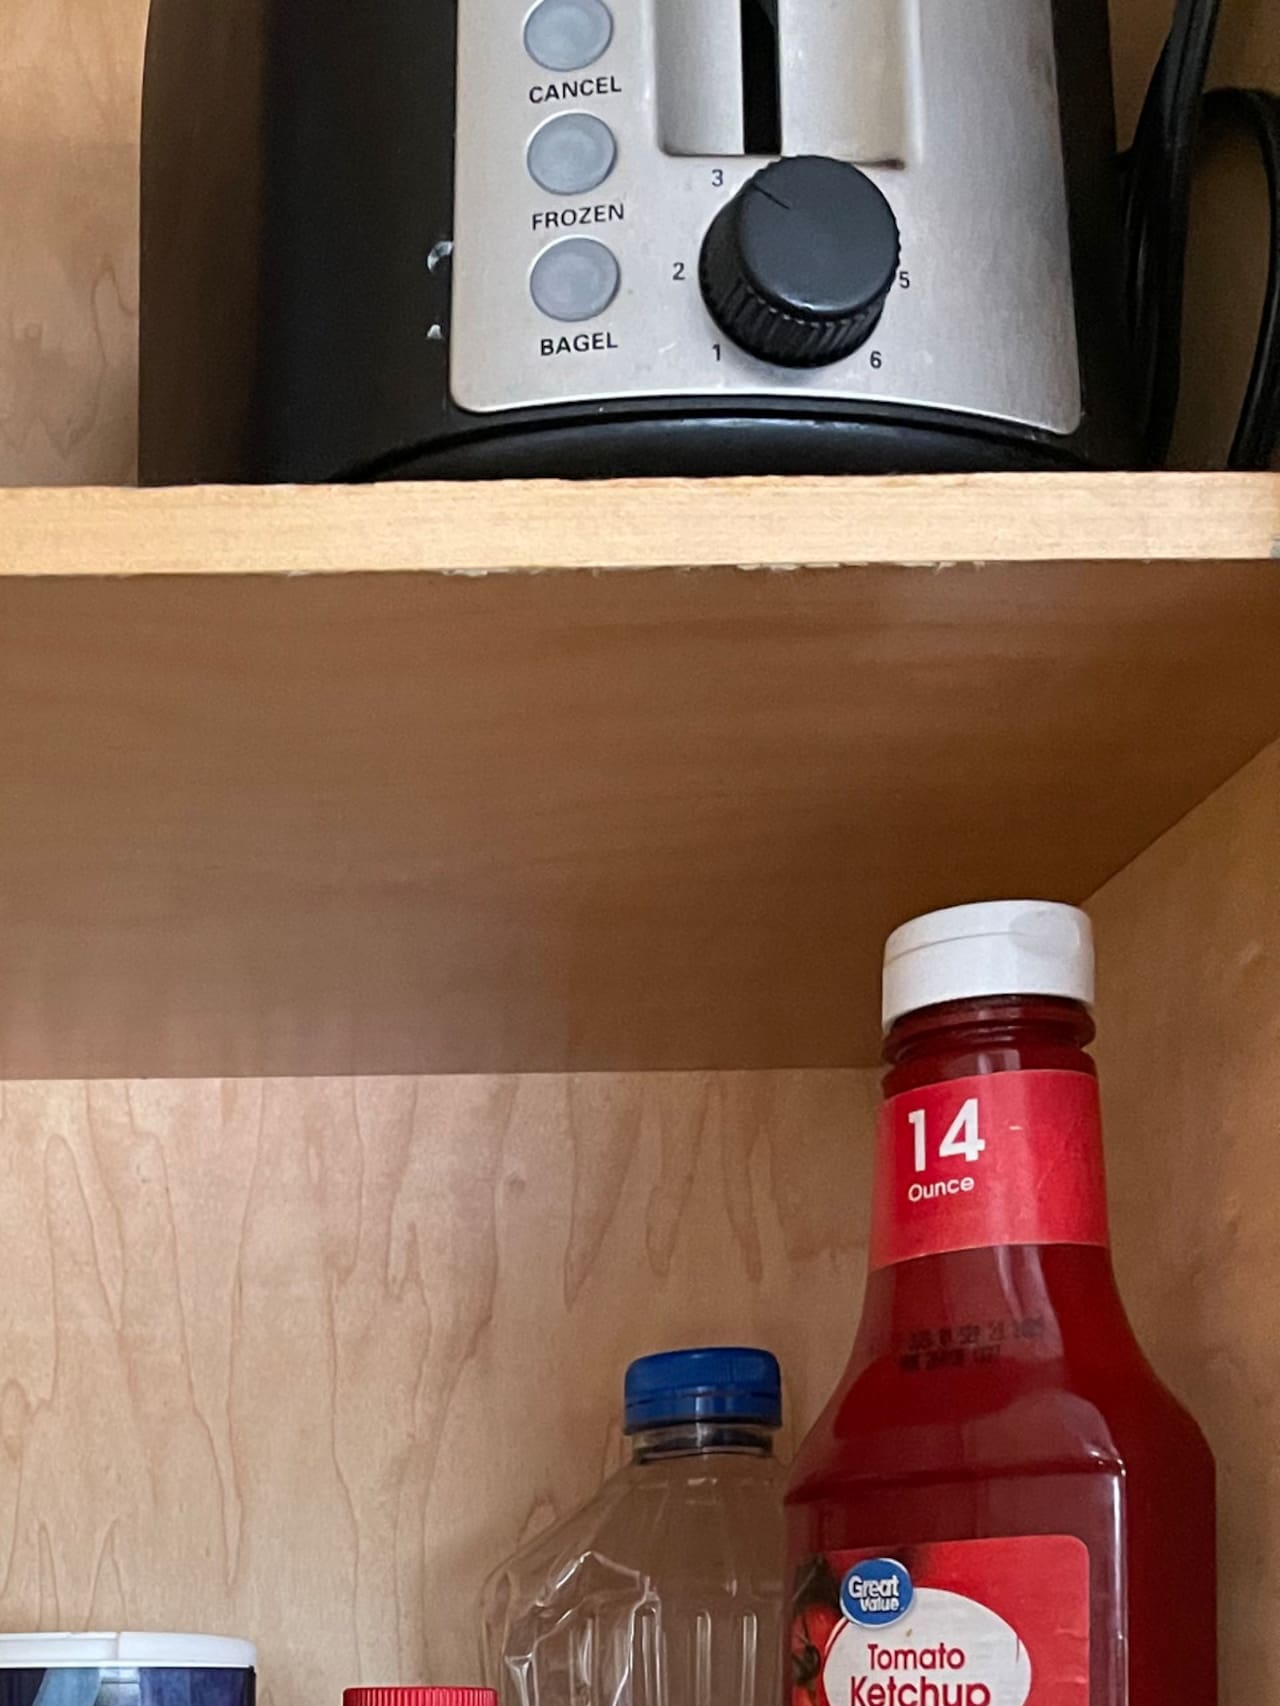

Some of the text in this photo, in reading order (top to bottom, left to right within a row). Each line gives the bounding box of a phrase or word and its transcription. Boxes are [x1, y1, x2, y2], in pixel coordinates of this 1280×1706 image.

[528, 76, 621, 103] CANCEL
[711, 169, 723, 187] 3
[531, 204, 625, 230] FROZEN
[672, 263, 686, 281] 2
[898, 271, 910, 289] 5
[540, 332, 618, 357] BAGEL
[712, 344, 721, 361] 1
[870, 351, 882, 369] 6
[908, 1098, 986, 1171] 14
[908, 1176, 975, 1202] Ounce
[848, 1575, 900, 1600] Great
[859, 1594, 901, 1614] Value
[867, 1643, 966, 1672] Tomato
